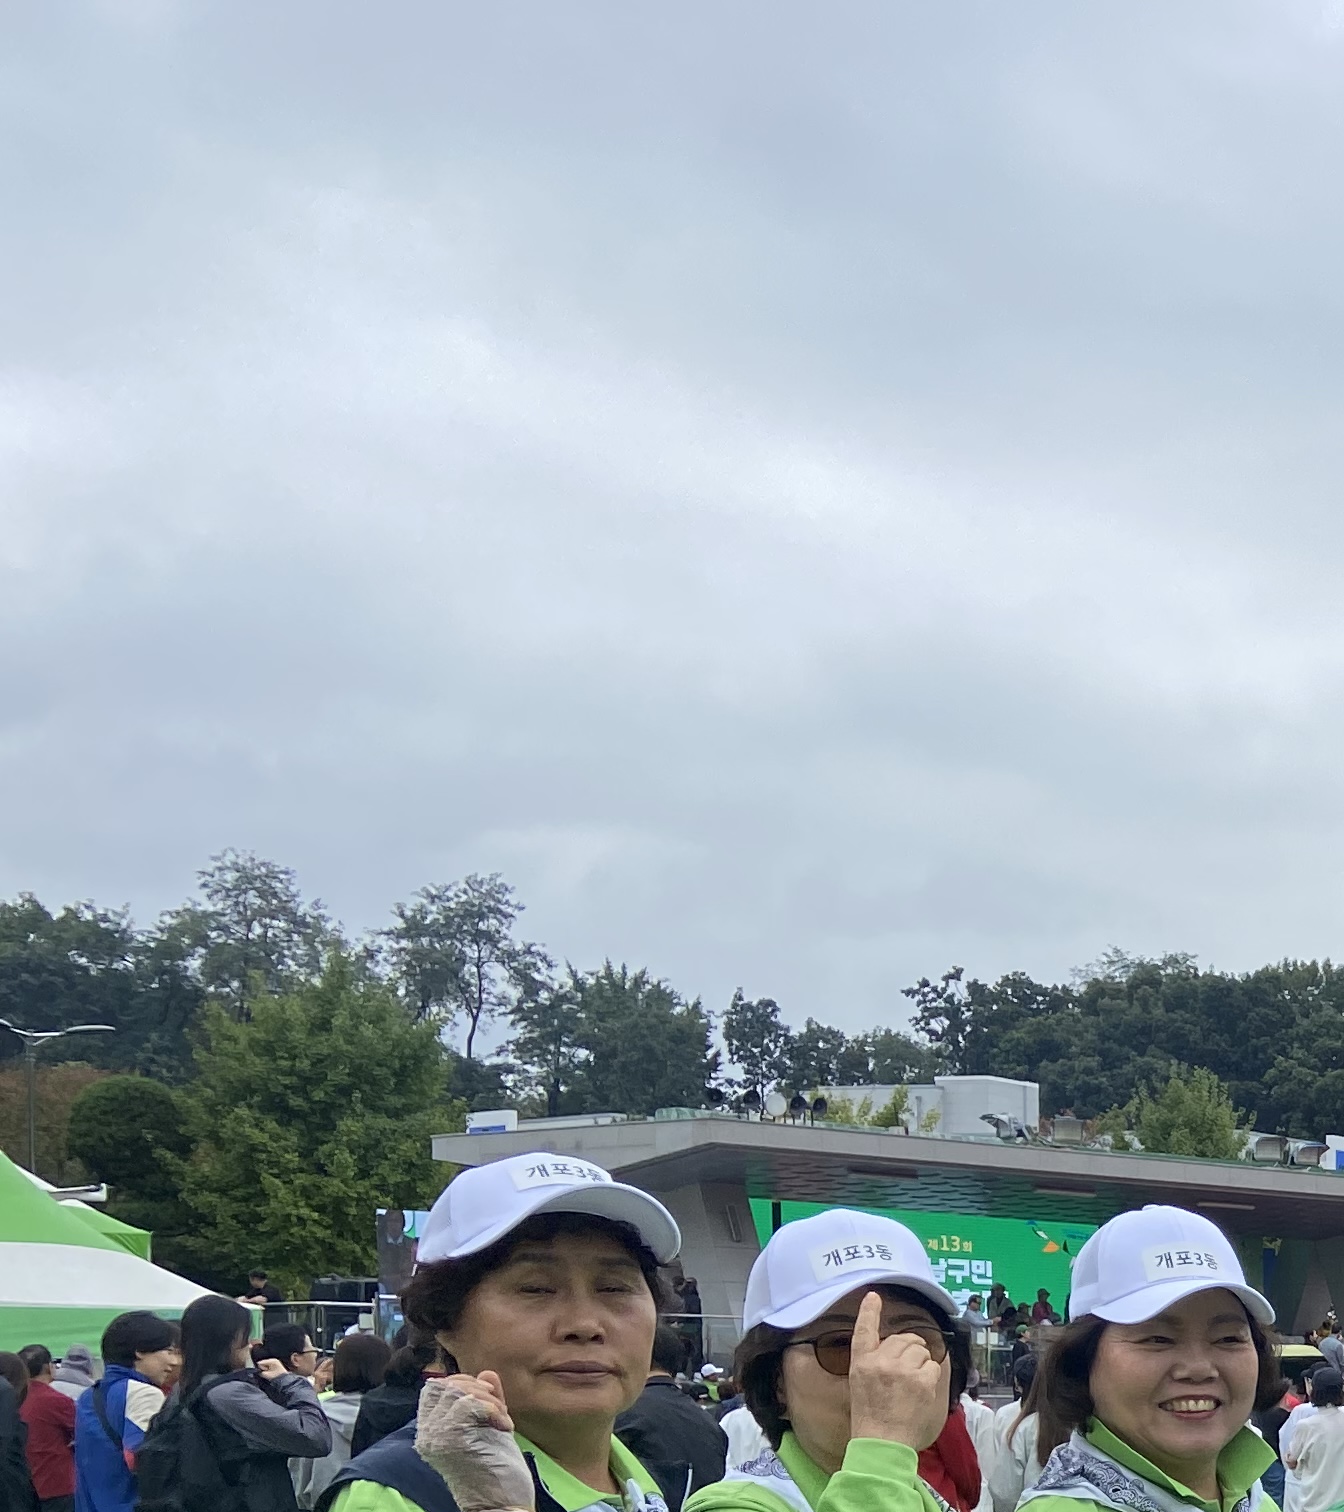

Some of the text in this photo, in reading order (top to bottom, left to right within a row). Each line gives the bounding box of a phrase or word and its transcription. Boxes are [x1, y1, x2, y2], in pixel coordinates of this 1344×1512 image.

[927, 1234, 973, 1252] 제13회
[823, 1244, 893, 1267] 개포3동
[1154, 1250, 1218, 1270] 개포3동
